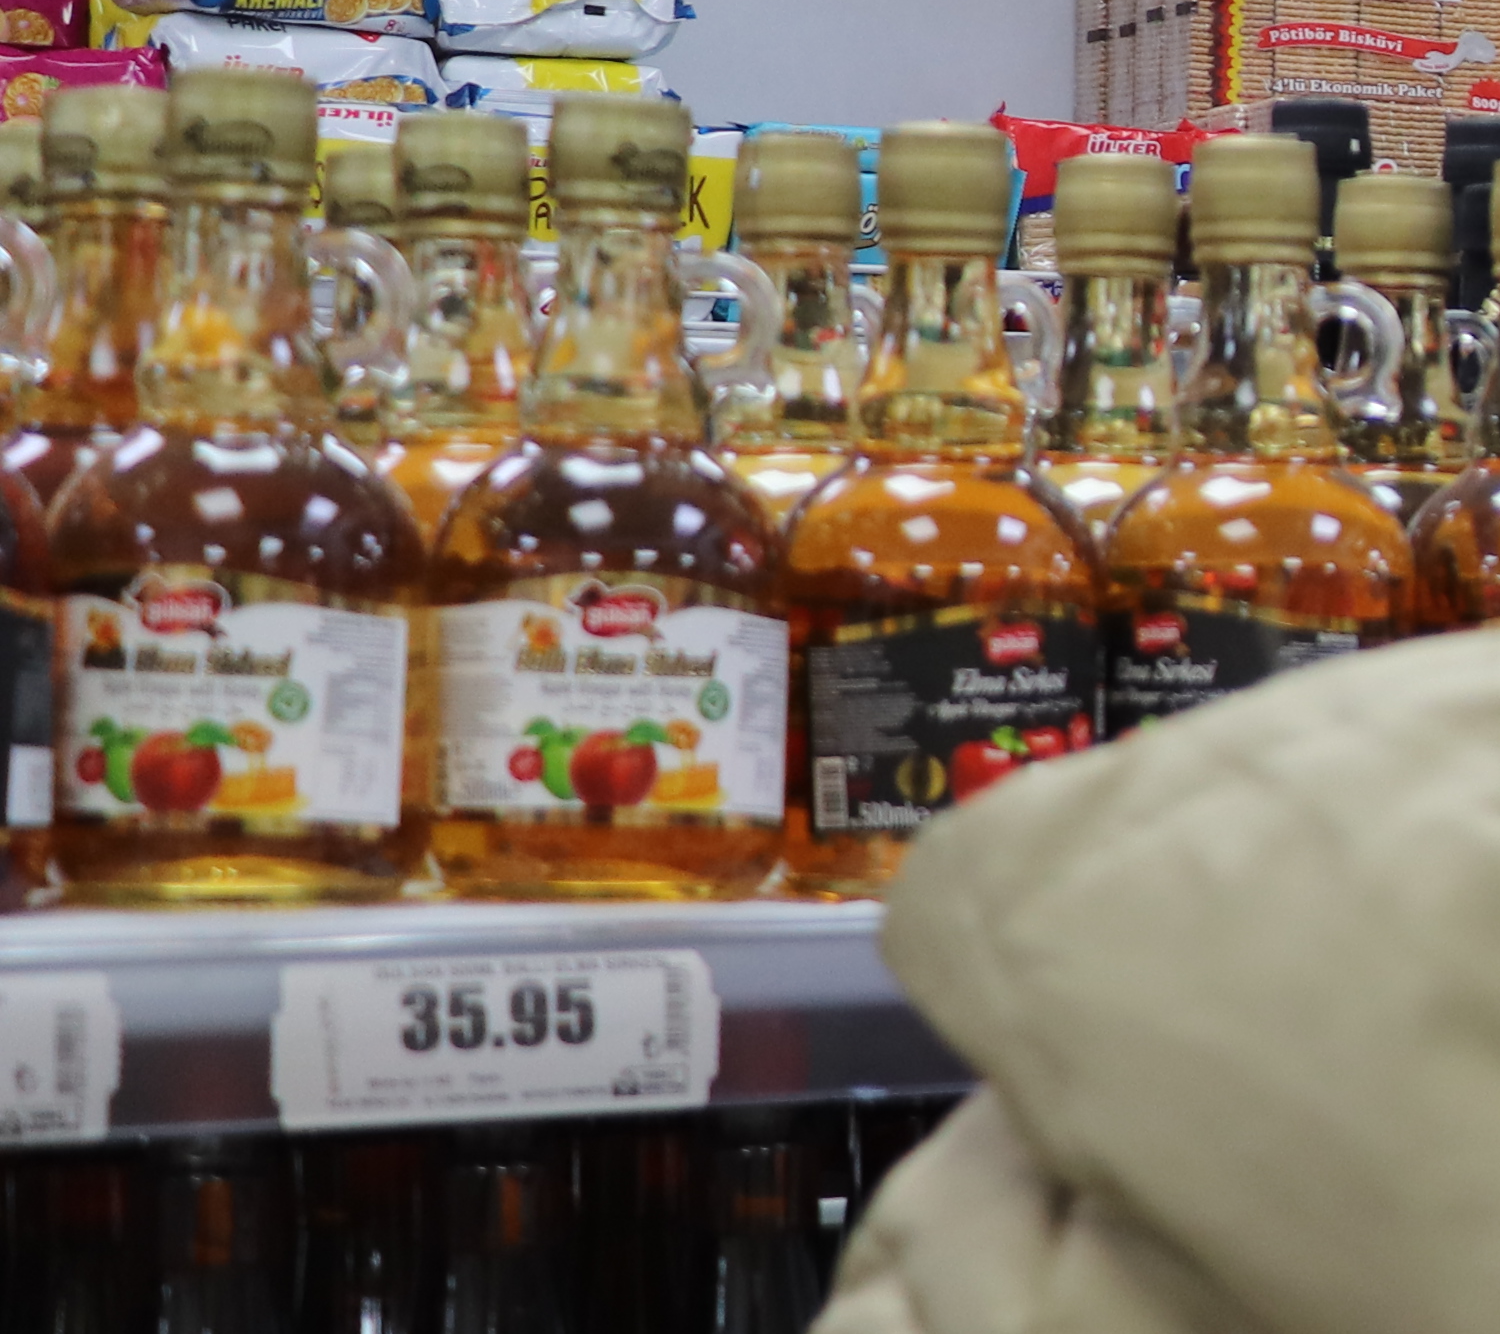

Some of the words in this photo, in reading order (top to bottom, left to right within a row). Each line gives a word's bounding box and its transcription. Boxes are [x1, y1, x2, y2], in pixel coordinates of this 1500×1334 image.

[1270, 27, 1334, 43] Pötibör
[1338, 31, 1403, 52] Bisküvi
[1273, 78, 1306, 93] 4'lü
[1310, 80, 1394, 96] Ekonomik
[1398, 84, 1442, 99] Paket
[1086, 133, 1162, 157] ÜLKER
[401, 977, 595, 1052] 35.95
